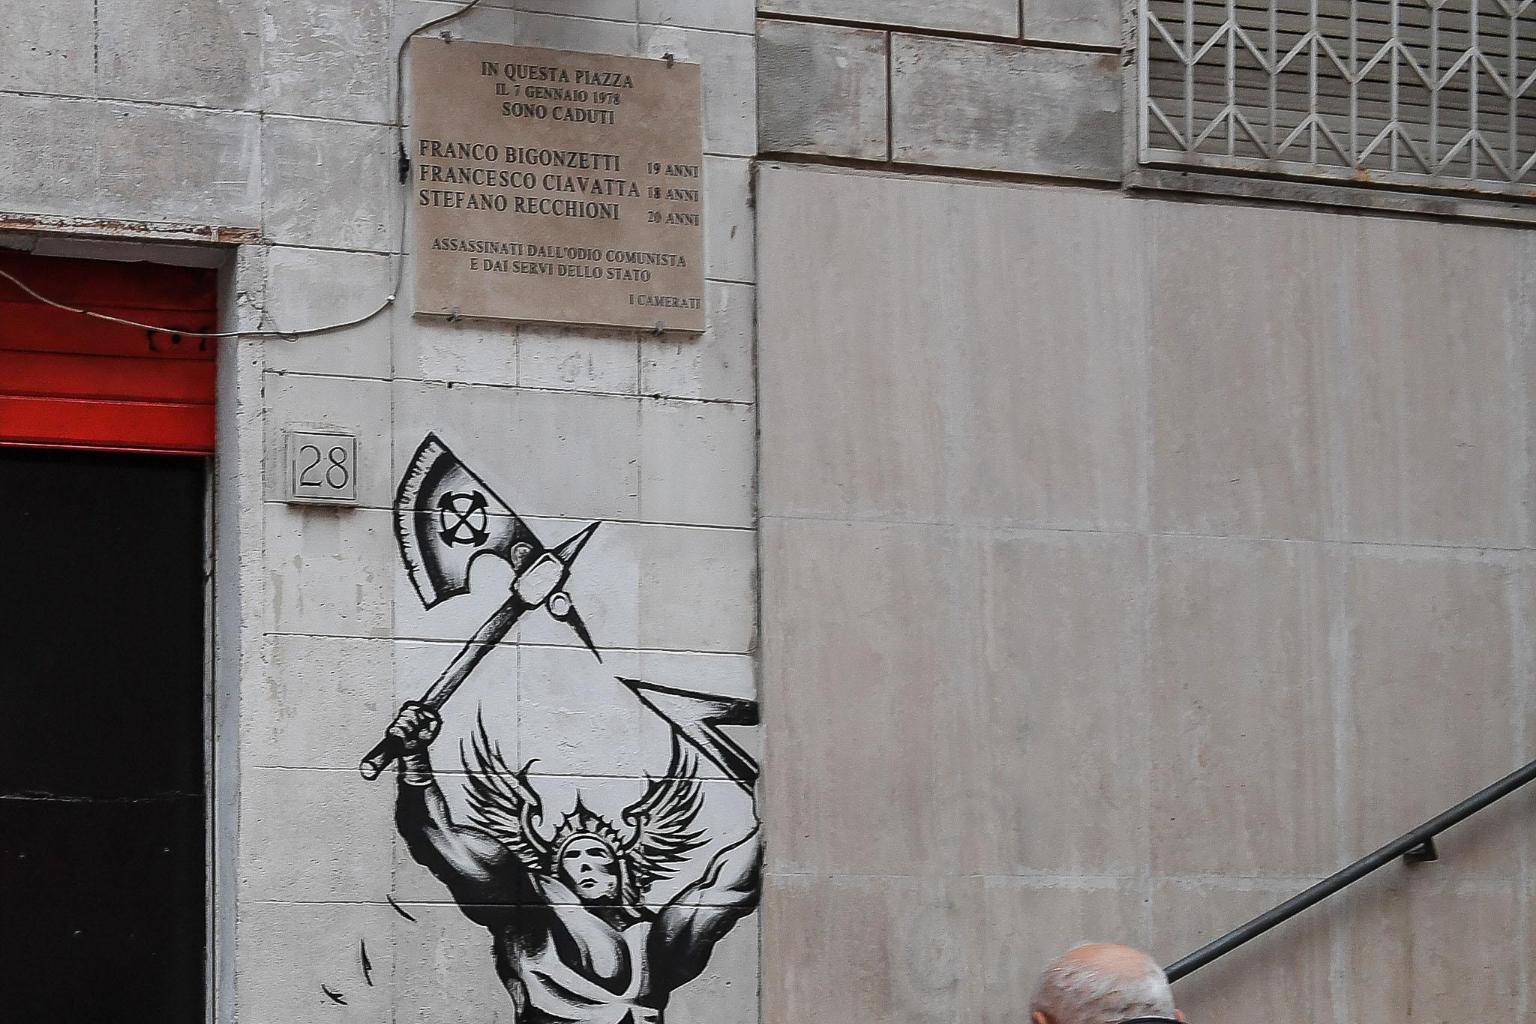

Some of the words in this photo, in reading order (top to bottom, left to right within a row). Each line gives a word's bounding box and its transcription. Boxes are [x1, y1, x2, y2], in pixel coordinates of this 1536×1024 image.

[480, 61, 499, 77] IN
[504, 63, 570, 83] QUESTA
[575, 69, 634, 88] PIAZZA
[495, 83, 510, 96] IL
[514, 84, 521, 97] 7
[525, 86, 588, 103] GENNAIO
[592, 91, 621, 106] 1978
[502, 102, 548, 120] SONO
[552, 106, 615, 125] CADUTI
[419, 139, 498, 162] FRANCO
[505, 146, 621, 172] BIGONZETTI
[647, 161, 662, 175] 19
[665, 163, 700, 179] ANNI
[419, 164, 537, 190] FRANCESCO
[543, 173, 641, 199] CIAVATTA
[647, 186, 662, 200] 18
[665, 188, 700, 203] ANNI
[419, 189, 508, 212] STEFANO
[515, 196, 621, 220] RECCHIONI
[647, 210, 662, 224] 20
[665, 212, 700, 227] ANNI
[432, 238, 523, 257] ASSASSINATI
[527, 244, 602, 262] DALL'ODIO
[606, 250, 687, 268] COMUNISTA
[470, 257, 479, 271] E
[483, 258, 509, 273] DAI
[512, 261, 554, 276] SERVI
[557, 264, 603, 280] DELLO
[606, 267, 652, 283] STATO
[628, 294, 634, 306] I
[637, 294, 701, 310] CAMERATI
[300, 445, 349, 489] 28
